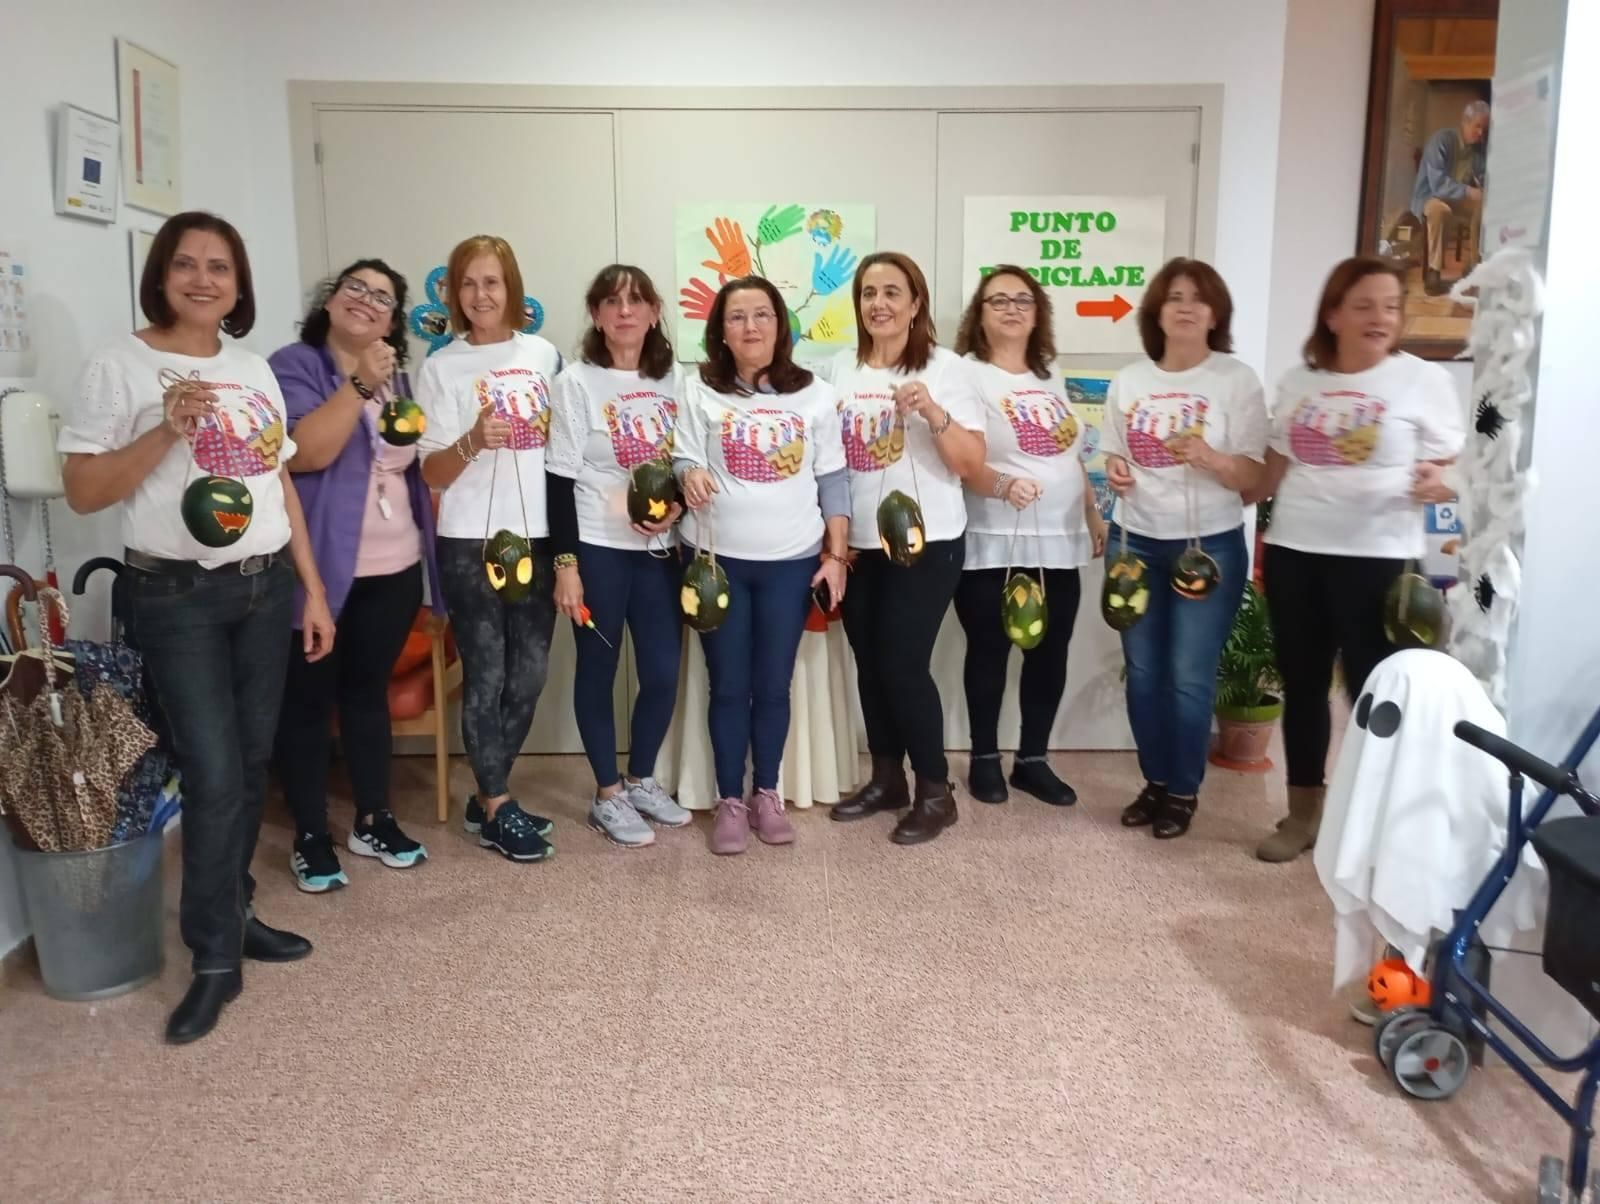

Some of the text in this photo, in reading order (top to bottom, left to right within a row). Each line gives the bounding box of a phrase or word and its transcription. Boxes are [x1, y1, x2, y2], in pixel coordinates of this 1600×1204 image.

[1010, 212, 1116, 233] PUNTO
[1040, 239, 1081, 260] DE
[979, 266, 1145, 287] ICLAJE
